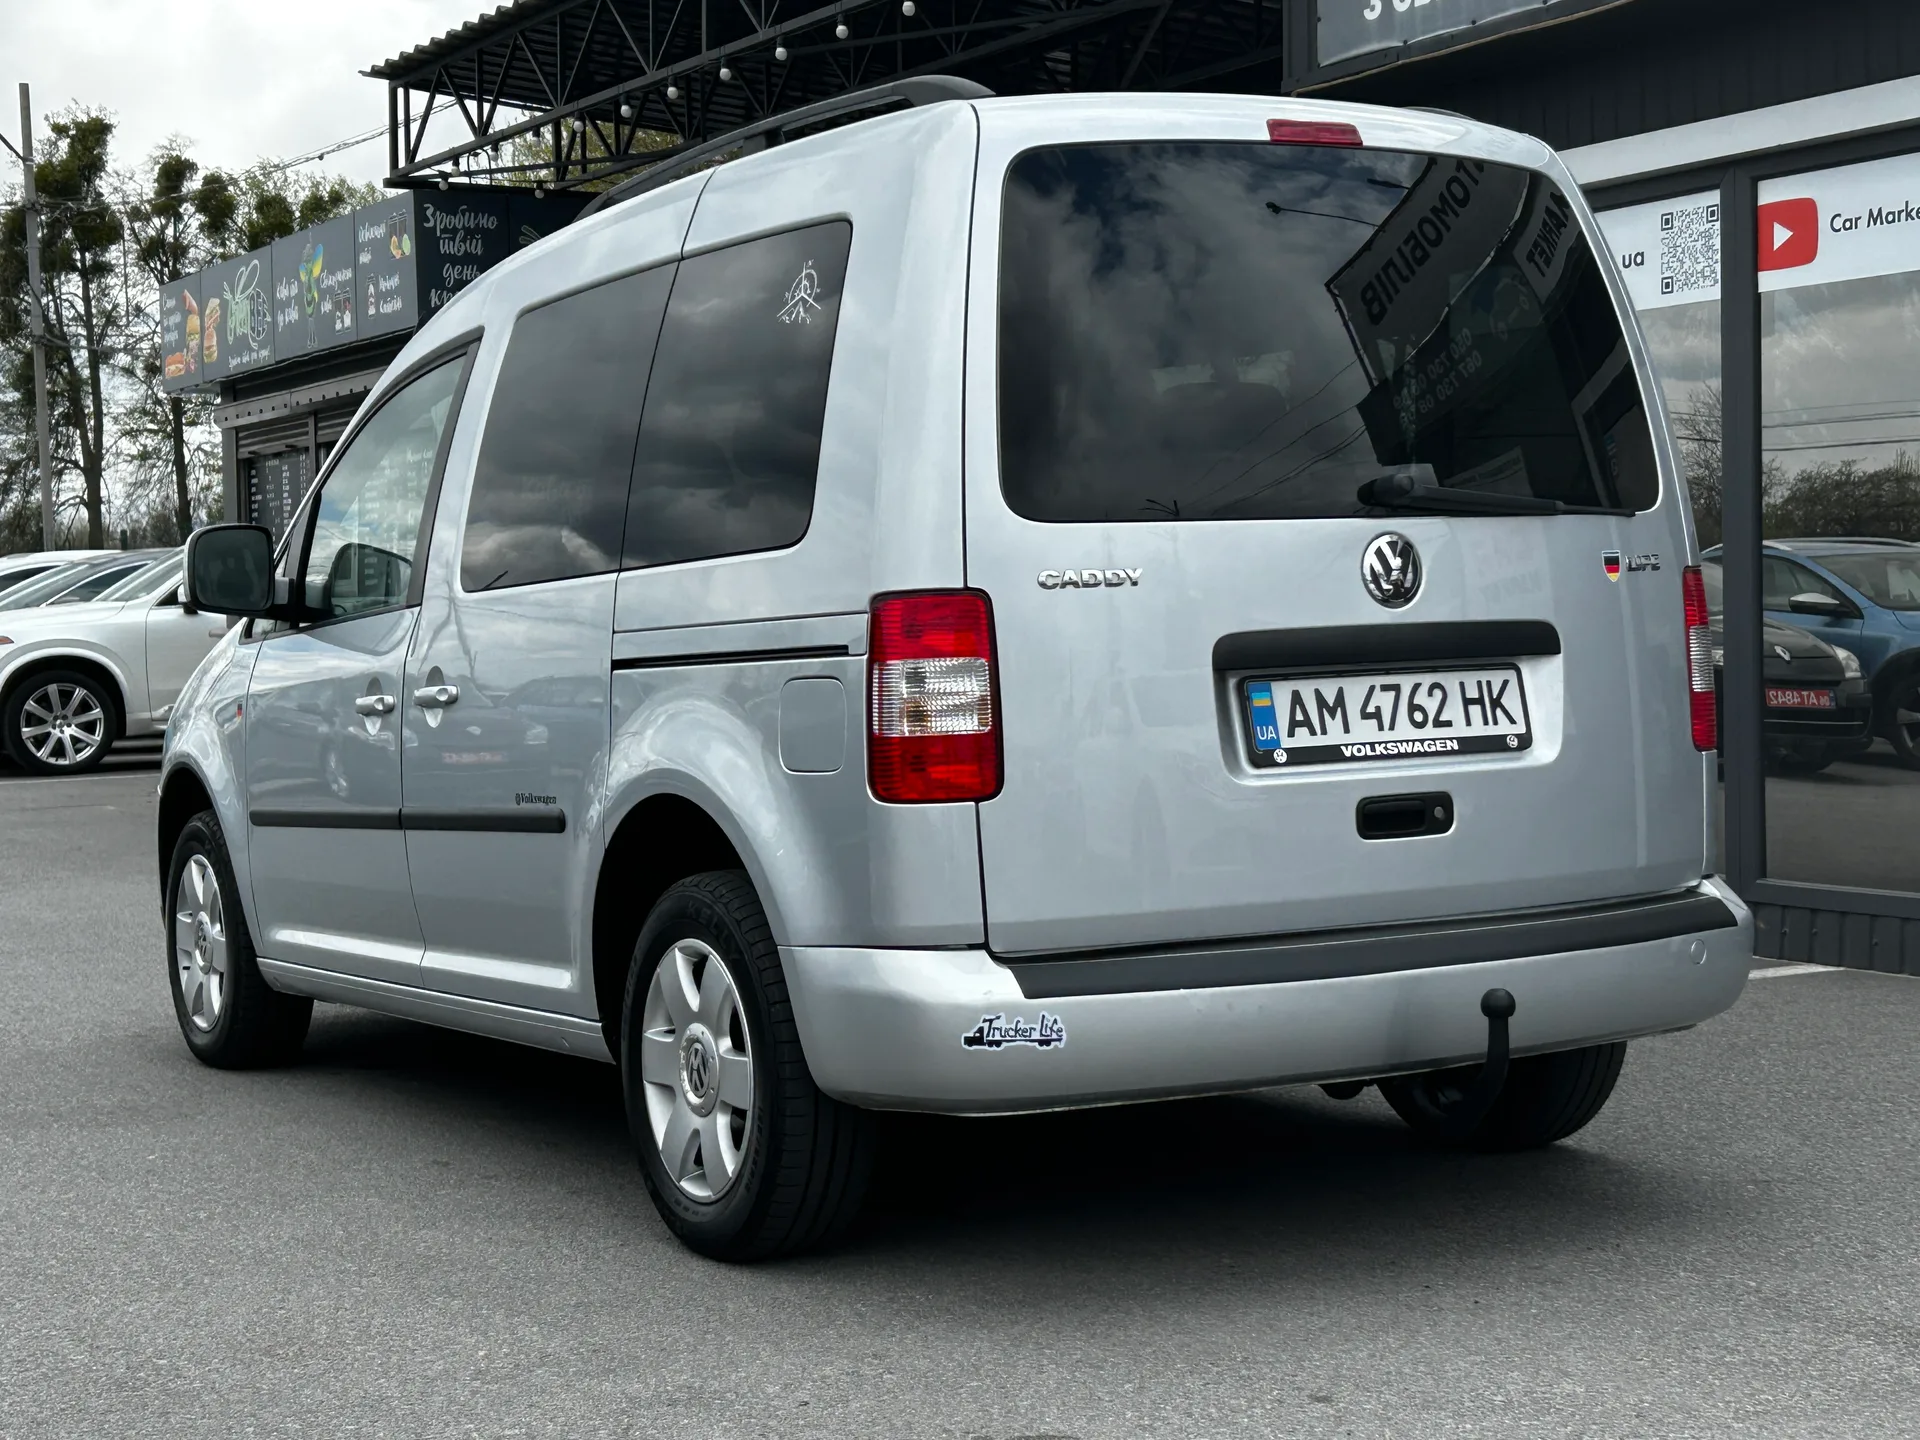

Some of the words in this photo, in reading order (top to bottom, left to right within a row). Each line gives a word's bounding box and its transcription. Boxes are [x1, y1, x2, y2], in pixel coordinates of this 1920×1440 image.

[423, 203, 499, 237] Зробимо
[1829, 212, 1862, 234] Car
[439, 229, 485, 256] твій
[1037, 568, 1143, 590] CADDY
[1287, 686, 1351, 738] AM
[1360, 682, 1453, 732] 4762
[1459, 679, 1517, 727] HK
[1256, 724, 1277, 741] UA
[1341, 739, 1459, 758] VOLKSWAGEN
[982, 1014, 1037, 1039] Trucker
[1040, 1013, 1064, 1039] Life
